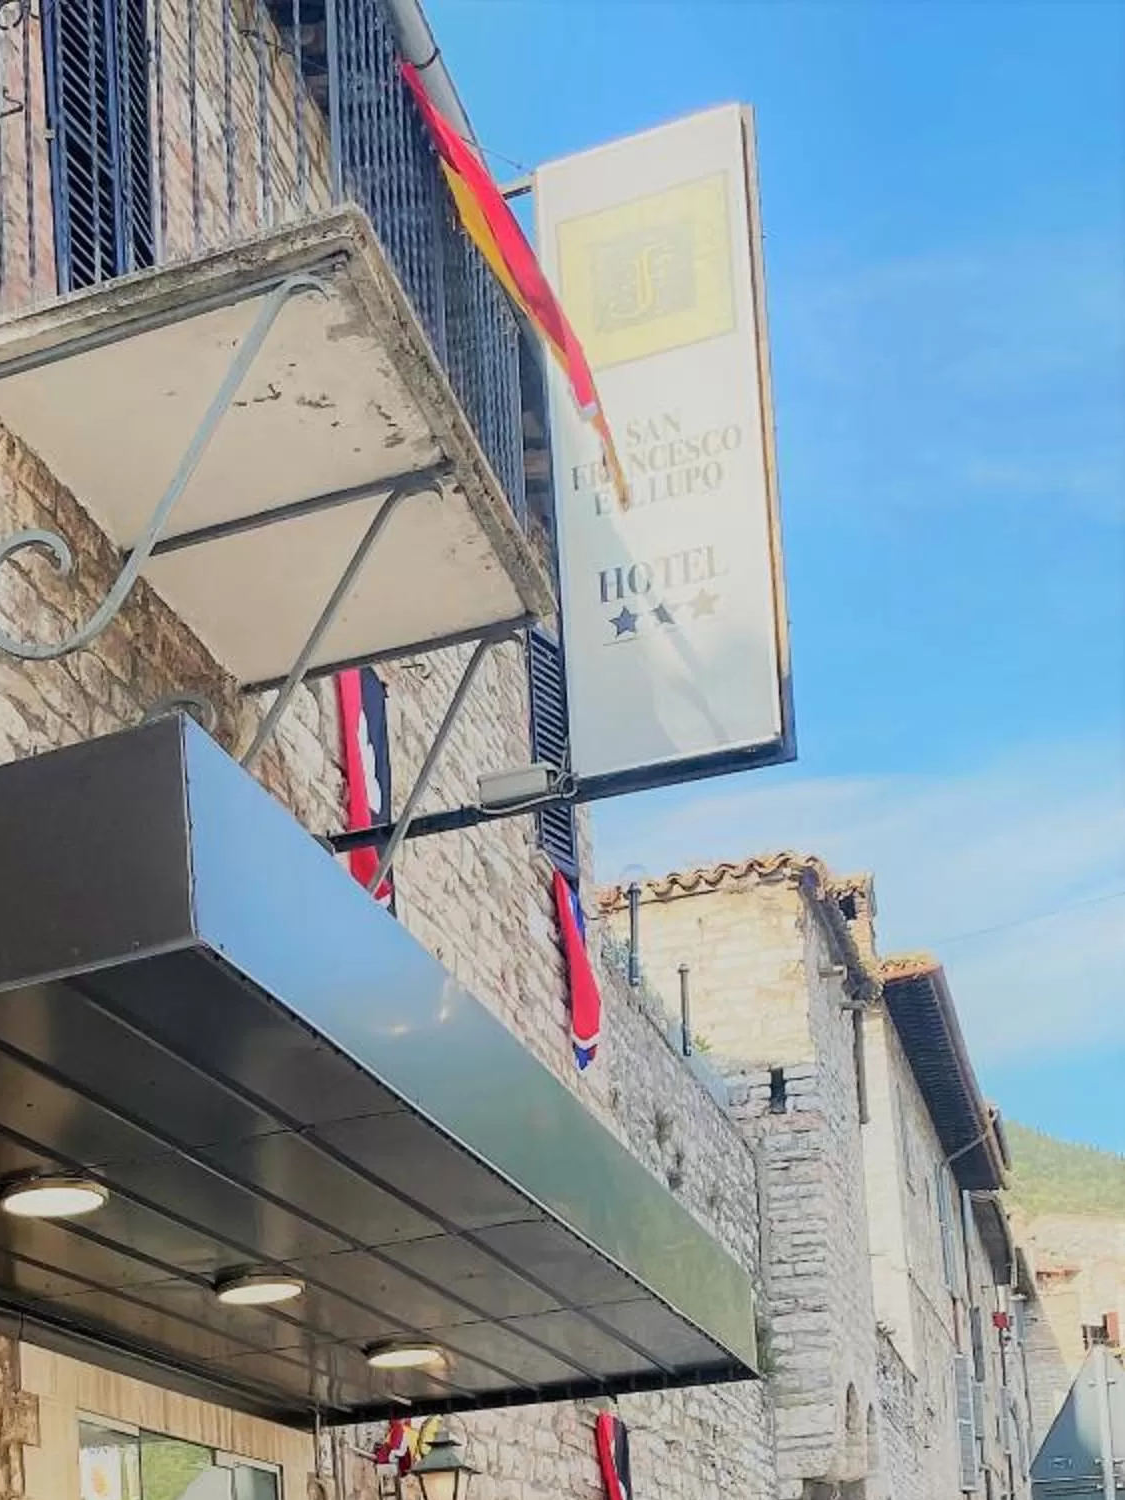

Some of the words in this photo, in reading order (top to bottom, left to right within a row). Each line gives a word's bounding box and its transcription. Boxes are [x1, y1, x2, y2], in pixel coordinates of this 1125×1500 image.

[626, 411, 682, 447] SAN
[571, 423, 743, 492] FRNCESCO
[593, 491, 612, 517] E
[597, 545, 728, 603] HOTEL
